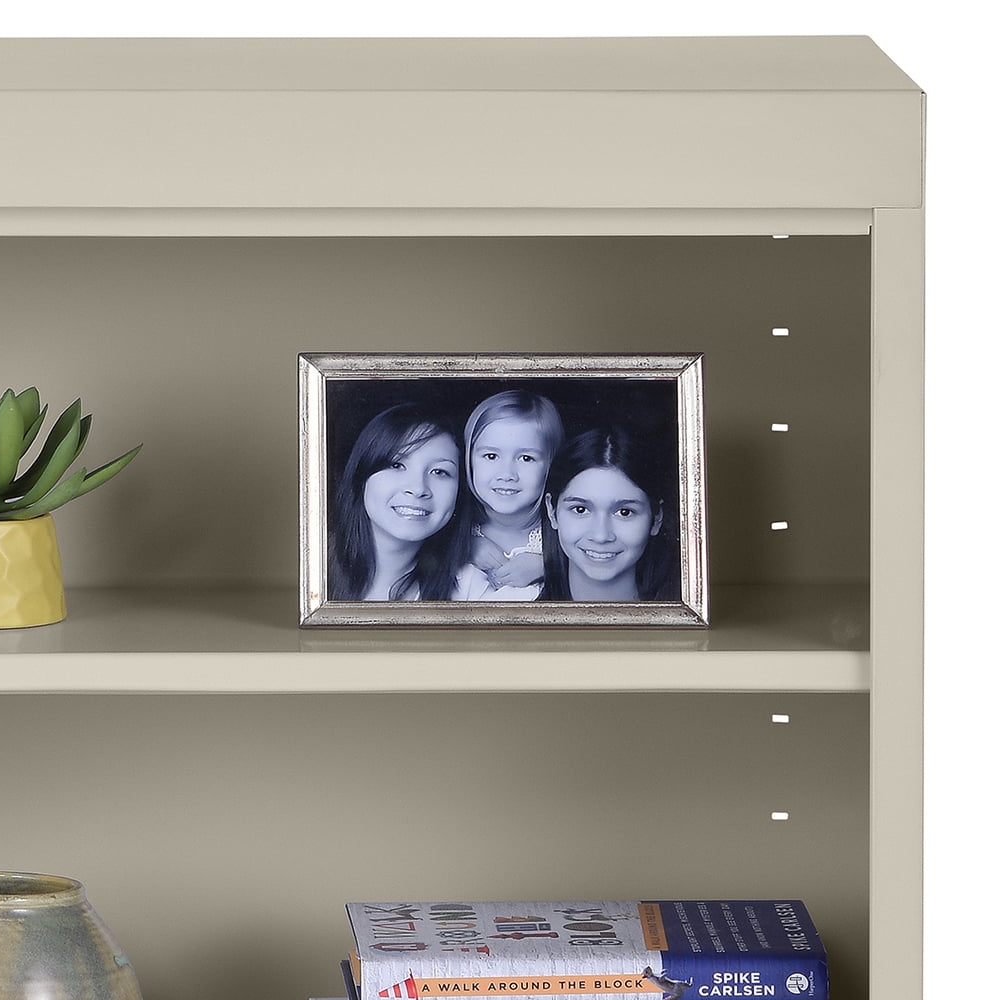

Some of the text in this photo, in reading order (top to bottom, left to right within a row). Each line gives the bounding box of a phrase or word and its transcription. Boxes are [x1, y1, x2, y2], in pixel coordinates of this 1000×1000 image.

[773, 903, 812, 951] SPIKE CARLSEN
[713, 972, 761, 984] SPIKE
[421, 979, 643, 992] A WALK AROUND THE BLOCK
[699, 984, 775, 997] CARLSEN
